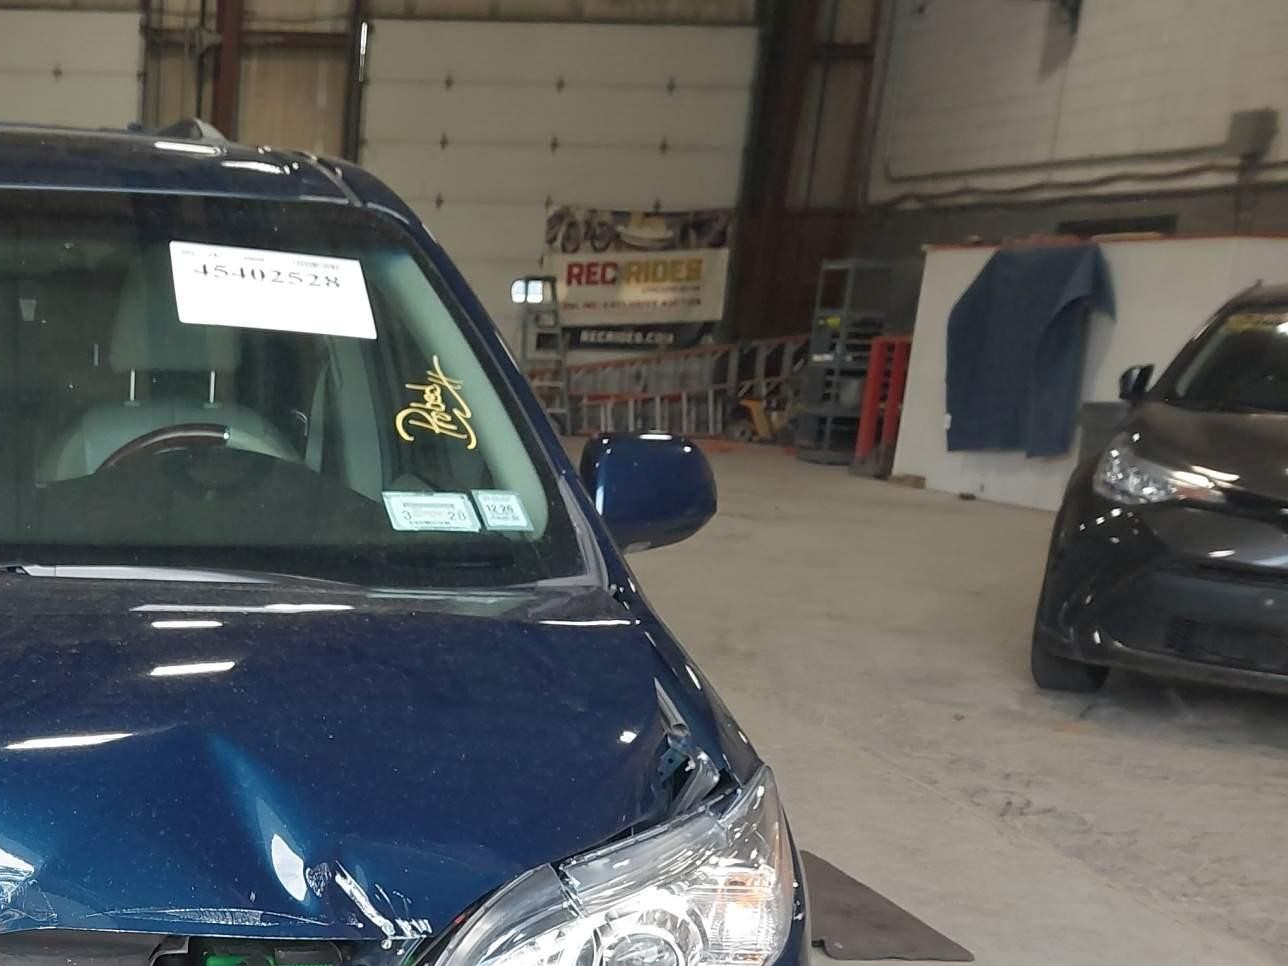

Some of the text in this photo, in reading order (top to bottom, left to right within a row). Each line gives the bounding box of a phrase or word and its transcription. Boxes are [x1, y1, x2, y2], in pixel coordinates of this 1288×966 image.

[194, 263, 341, 288] 45402528
[567, 258, 702, 287] REC RIDES
